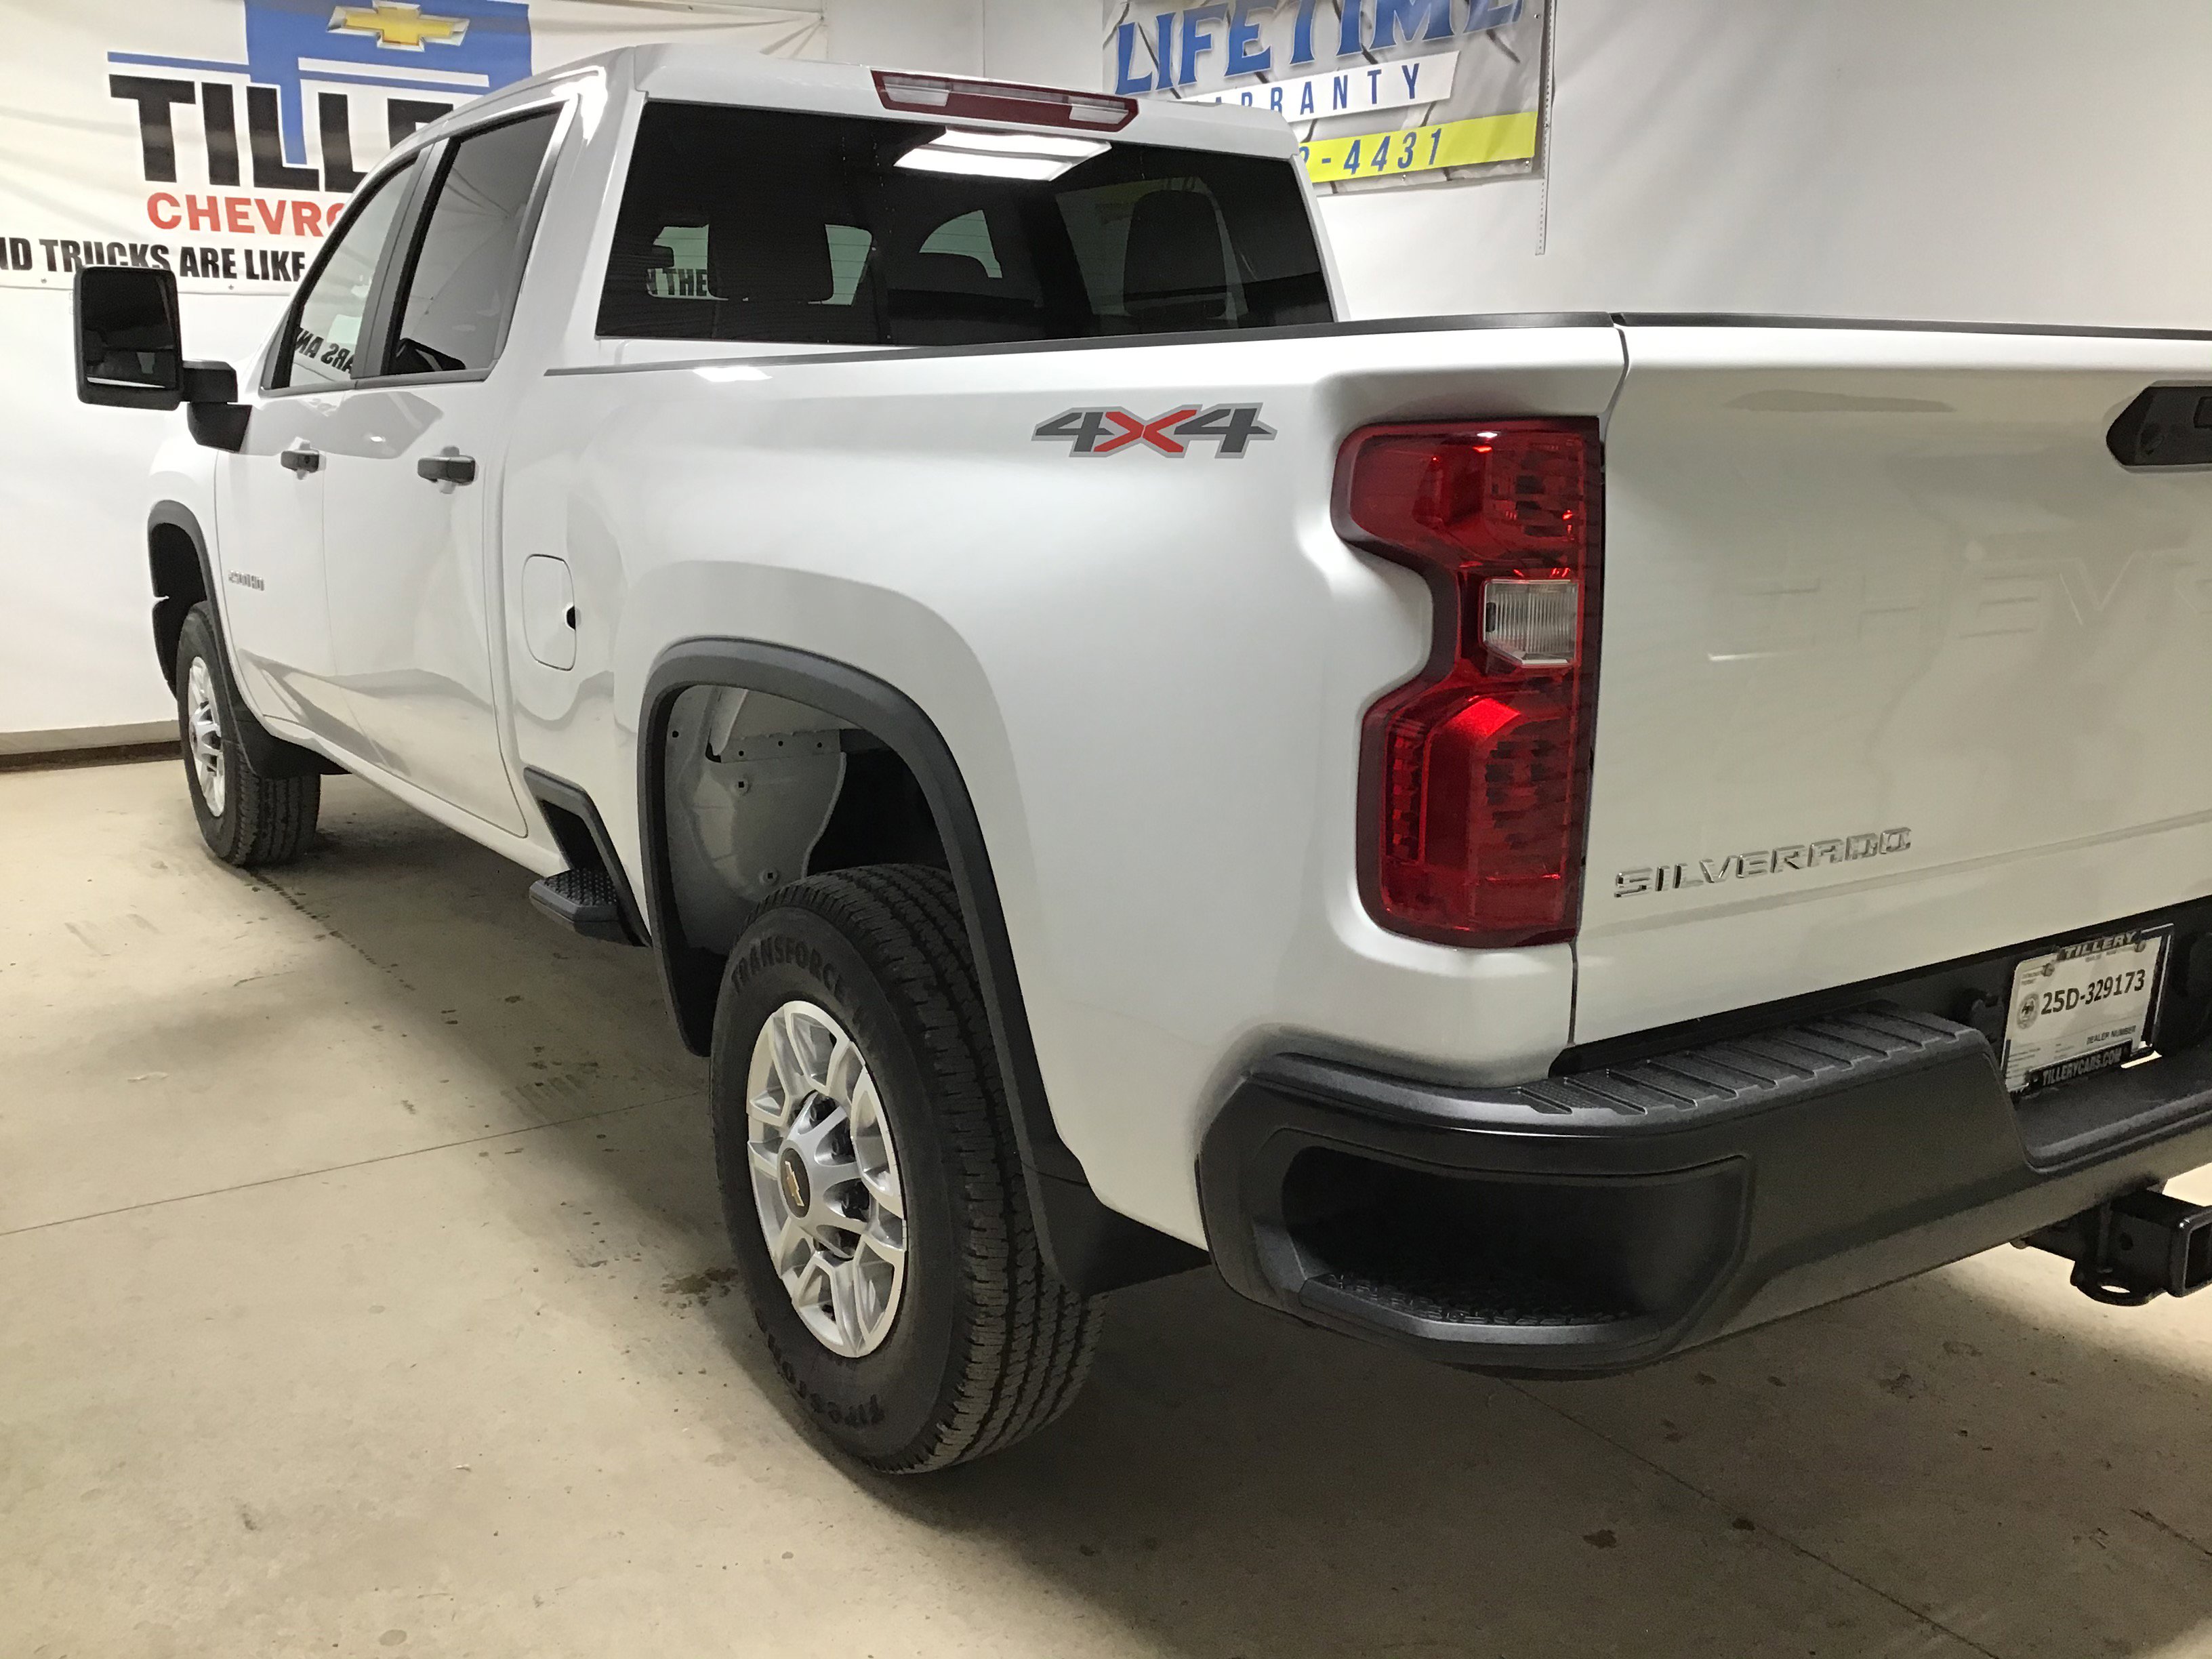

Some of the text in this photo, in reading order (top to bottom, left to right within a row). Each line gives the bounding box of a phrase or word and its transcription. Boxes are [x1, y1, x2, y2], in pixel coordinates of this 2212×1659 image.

[108, 74, 453, 193] TILL
[39, 239, 170, 272] TRUCKS
[180, 246, 238, 279] ARE
[662, 268, 708, 296] THE
[1033, 404, 1276, 457] 4X4
[1614, 826, 1912, 899] SILVERADO
[2064, 931, 2137, 958] TILLERY
[2041, 968, 2146, 1015] 25D-329173
[2043, 1046, 2123, 1086] TILLERYCARS.COM
